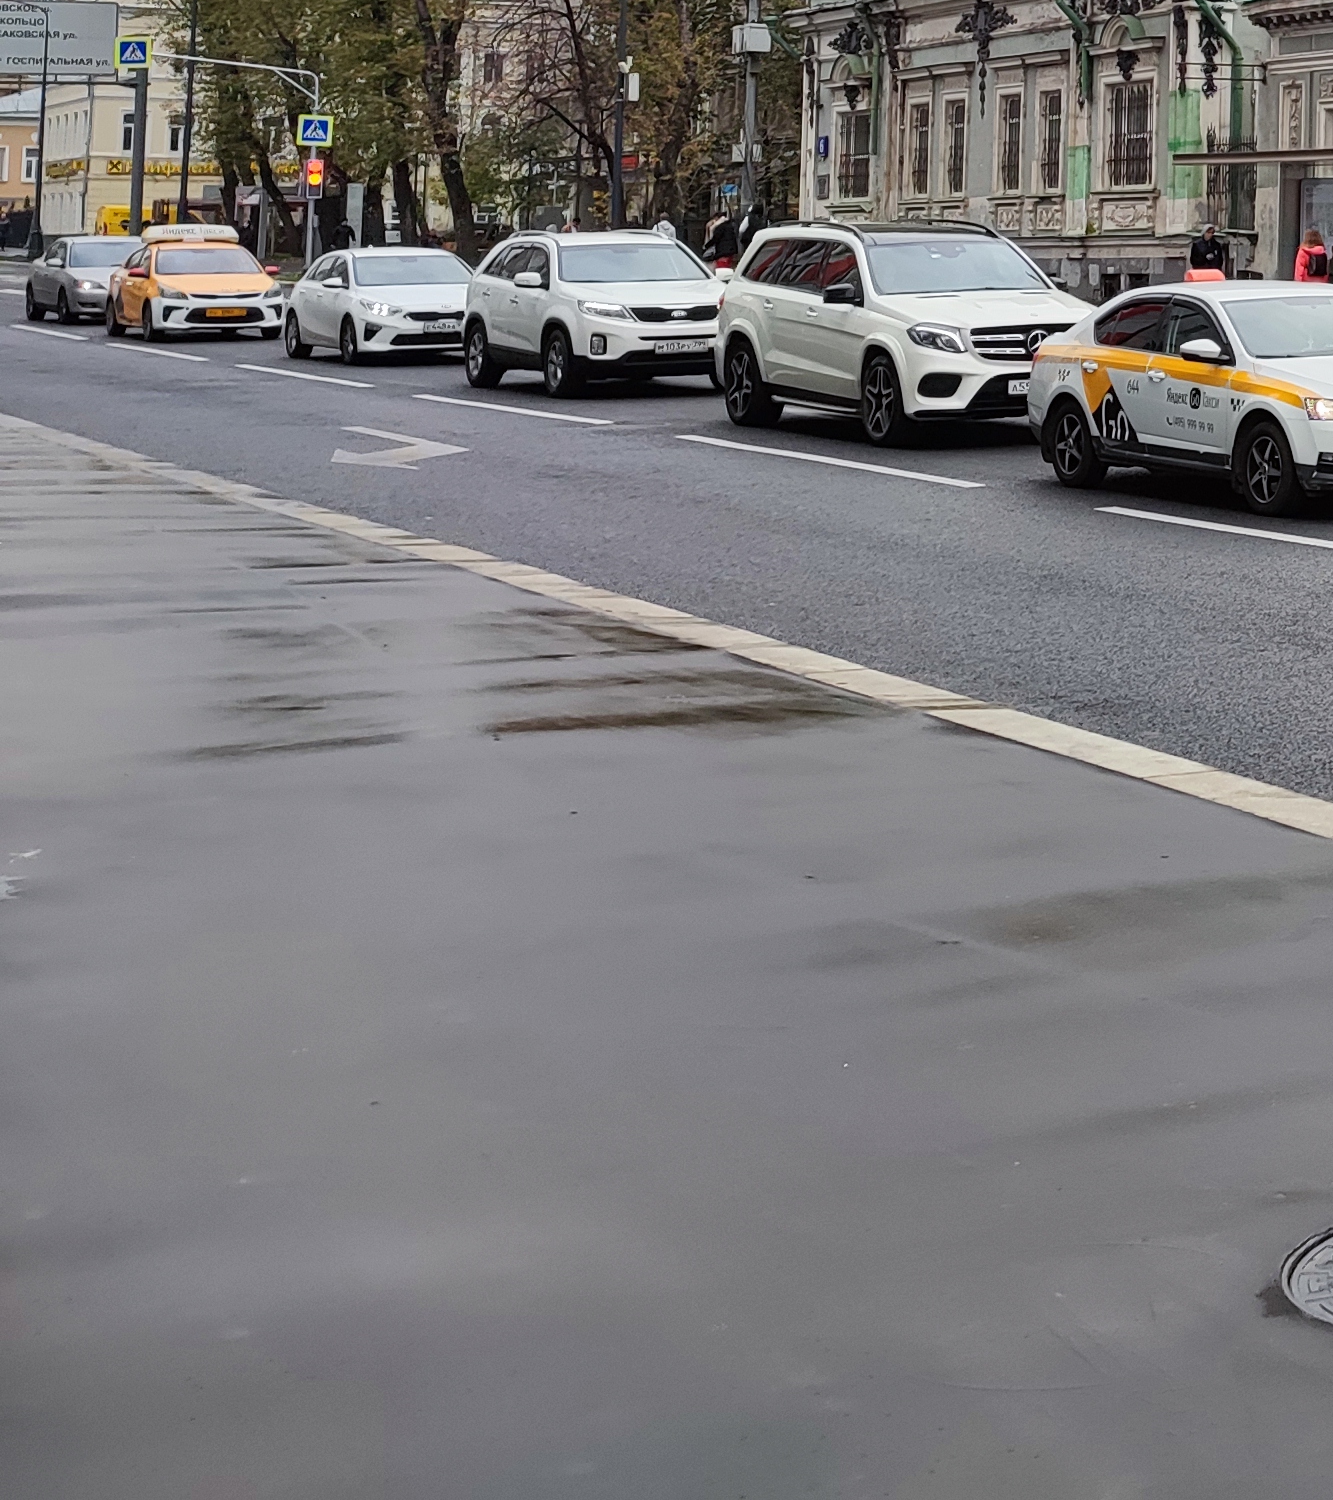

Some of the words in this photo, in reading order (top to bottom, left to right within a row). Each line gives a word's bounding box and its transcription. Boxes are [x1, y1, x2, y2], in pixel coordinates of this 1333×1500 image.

[0, 4, 39, 12] ВСКОЕ
[0, 17, 45, 27] КОЛЬЦО
[0, 30, 60, 39] АКОВСКАЯ
[820, 139, 825, 153] 6
[1127, 379, 1139, 395] 644
[1166, 387, 1188, 405] Яндекс
[1203, 391, 1220, 409] Такси
[1187, 418, 1197, 430] 999
[1199, 421, 1205, 432] 99
[1207, 422, 1214, 434] 99
